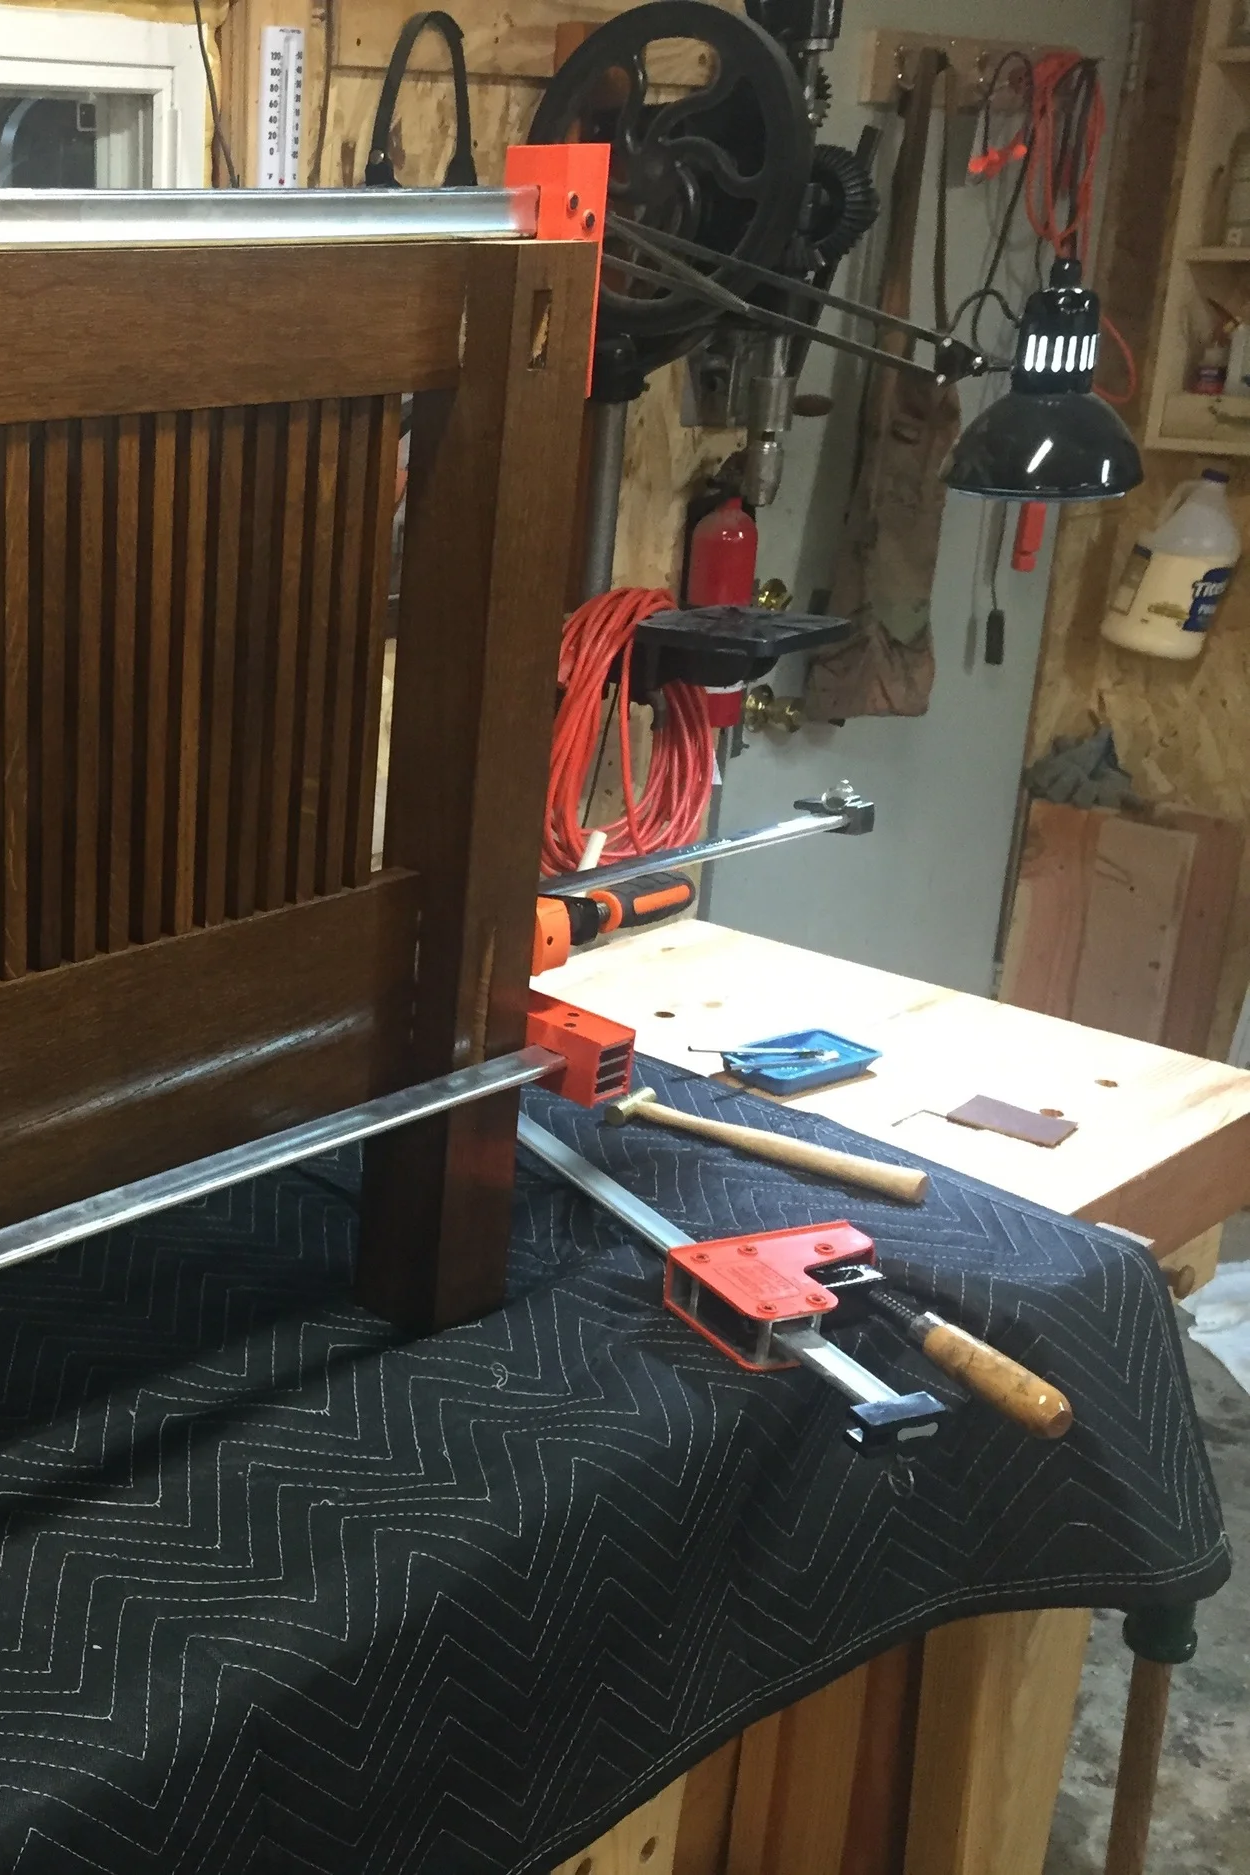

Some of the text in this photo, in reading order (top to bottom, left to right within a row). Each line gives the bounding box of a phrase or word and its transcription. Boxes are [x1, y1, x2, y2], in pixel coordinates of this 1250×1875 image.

[270, 51, 282, 61] 120
[270, 67, 281, 77] 100
[269, 83, 279, 93] 80
[268, 99, 278, 109] 60
[269, 115, 278, 124] 40
[268, 131, 277, 140] 20
